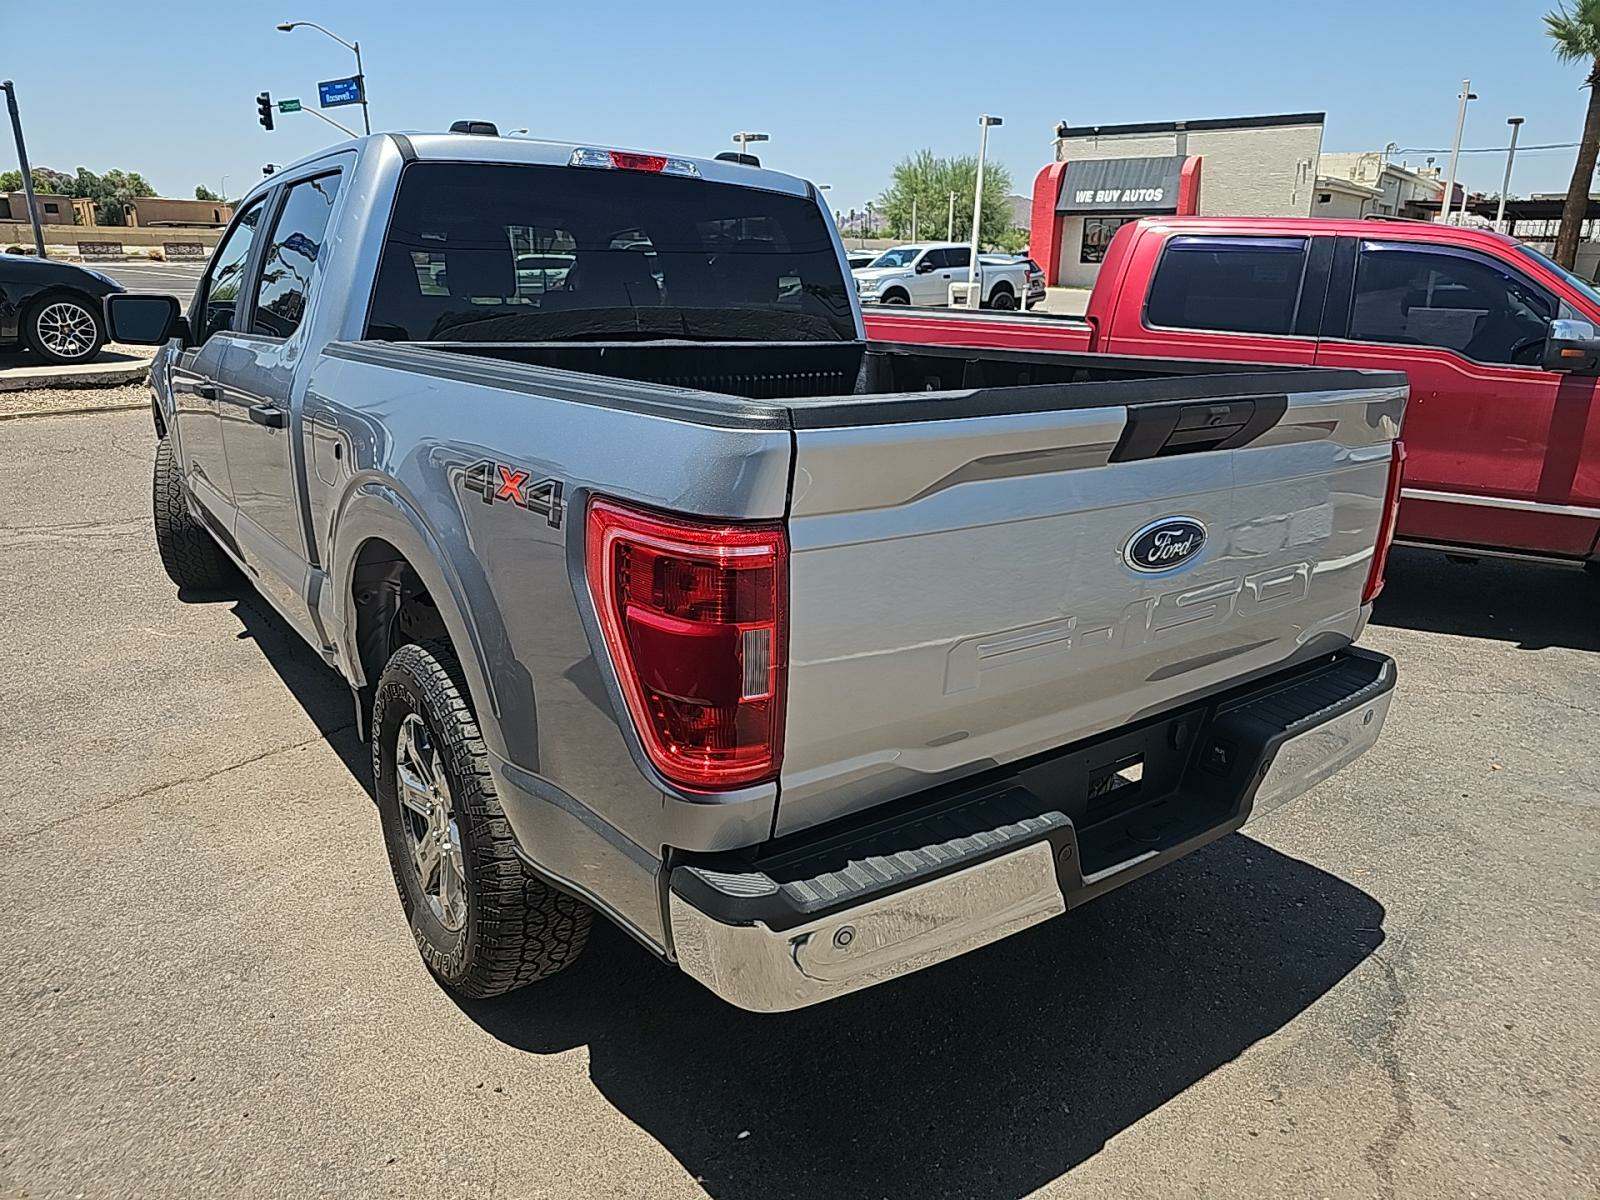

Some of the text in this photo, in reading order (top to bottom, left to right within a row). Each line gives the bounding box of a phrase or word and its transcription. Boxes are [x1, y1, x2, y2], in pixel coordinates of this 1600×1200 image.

[1075, 188, 1164, 203] WE BUY AUTOS
[1147, 528, 1196, 563] Ford
